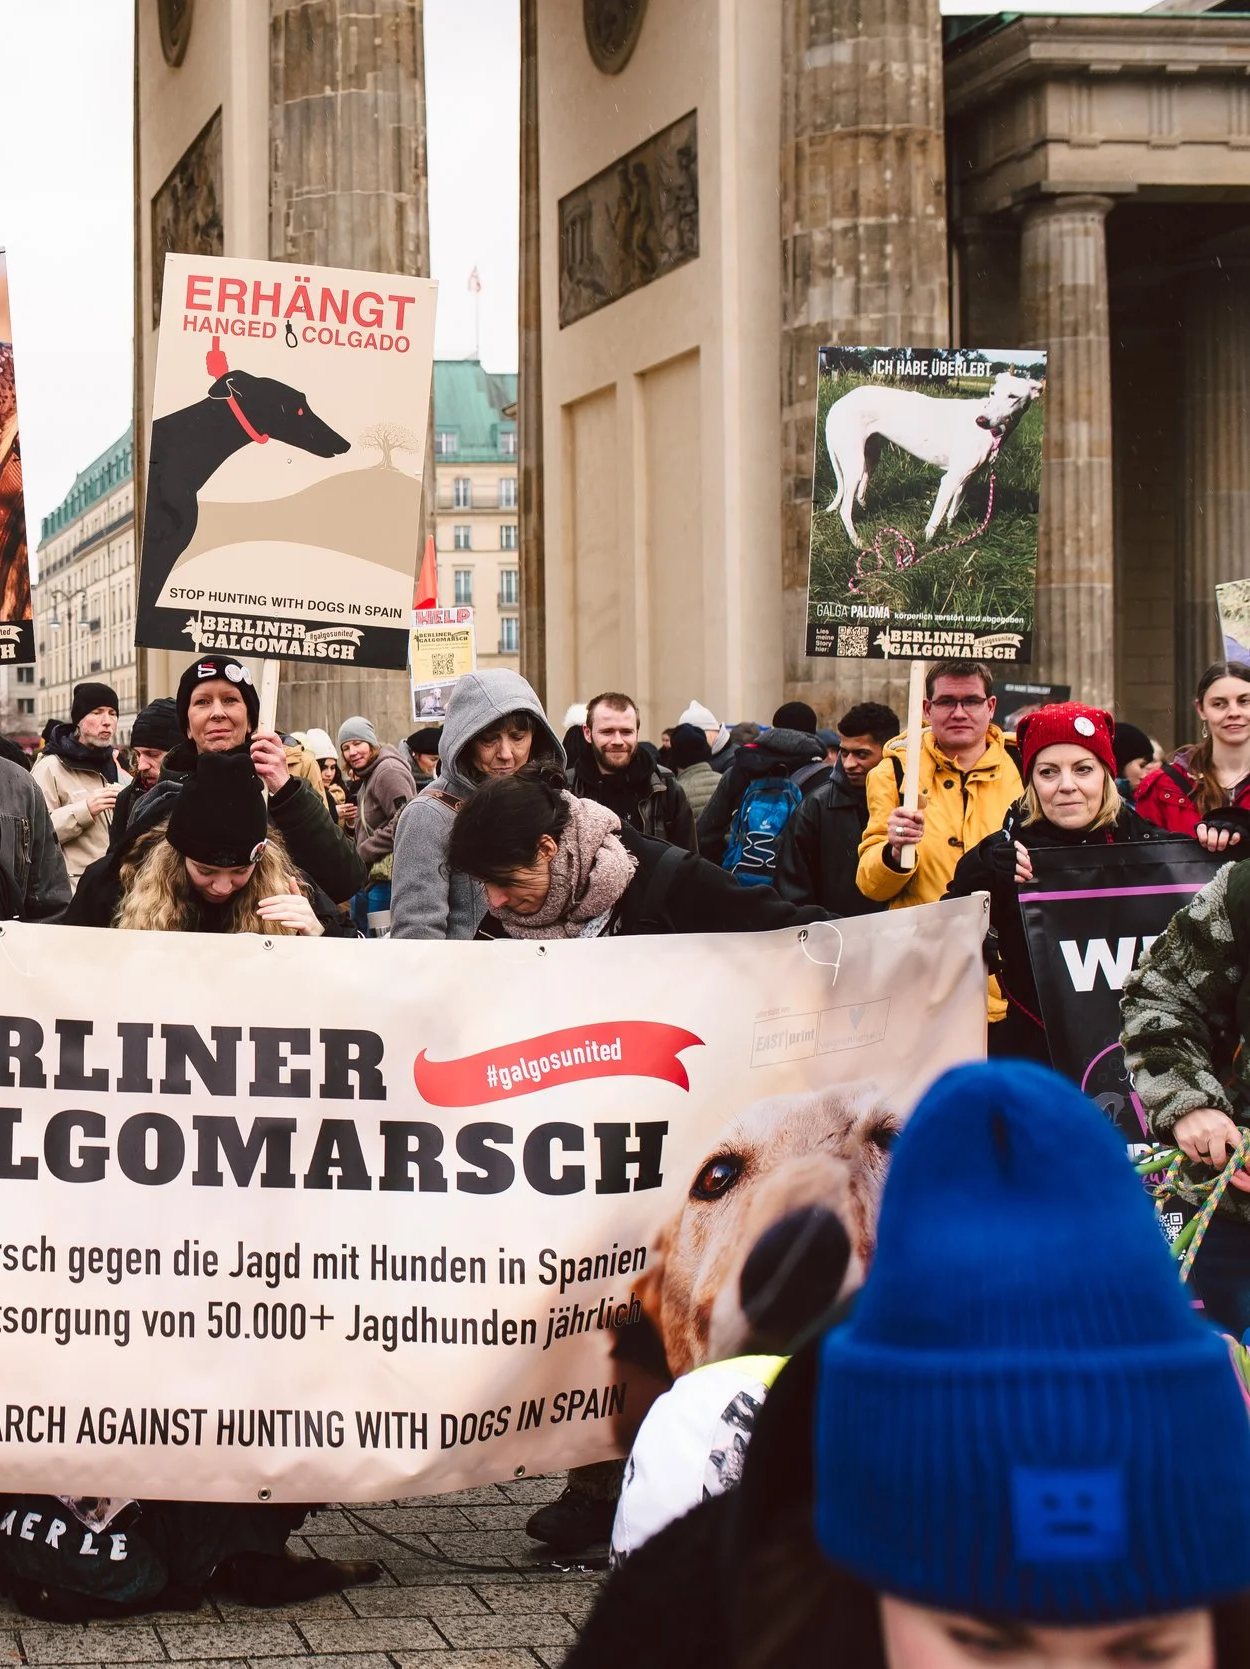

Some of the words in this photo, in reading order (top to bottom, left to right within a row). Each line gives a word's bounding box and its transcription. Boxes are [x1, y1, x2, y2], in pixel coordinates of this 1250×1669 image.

[185, 274, 416, 331] ERHÄNGT
[182, 314, 277, 339] HANGED
[302, 326, 411, 353] COLGADO
[873, 359, 893, 375] ICH
[896, 360, 929, 376] HABE
[931, 358, 992, 377] ÜBERLEBT
[169, 587, 205, 600] STOP
[208, 591, 268, 606] HUNTING
[271, 596, 304, 610] WITH
[307, 600, 345, 613] DOGS
[348, 603, 362, 615] IN
[364, 604, 403, 619] SPAIN
[416, 608, 470, 627] HELP
[816, 604, 848, 618] GALGA
[850, 604, 890, 619] PALOMA
[202, 615, 306, 639] BERLINER
[310, 629, 354, 641] #galgosunited
[890, 629, 975, 645] BERLINER
[201, 633, 355, 660] GALGOMARSCH
[890, 643, 1016, 660] GALGOMARSCH
[486, 1037, 622, 1090] #galgosunited
[68, 1245, 161, 1285] gegen
[173, 1239, 219, 1278] die
[228, 1240, 301, 1289] Jagd
[312, 1243, 360, 1280] mit
[370, 1243, 486, 1284] Hunden
[498, 1246, 526, 1285] in
[538, 1242, 647, 1294] Spanien
[141, 1309, 195, 1338] von
[207, 1301, 335, 1340] 50.000+
[344, 1304, 536, 1352] Jagdhunden
[542, 1292, 642, 1351] jährlich
[76, 1406, 207, 1446] AGAINST
[216, 1408, 344, 1448] HUNTING
[355, 1410, 428, 1450] WITH
[440, 1405, 512, 1450] DOGS
[516, 1397, 546, 1432] IN
[549, 1382, 627, 1424] SPAIN
